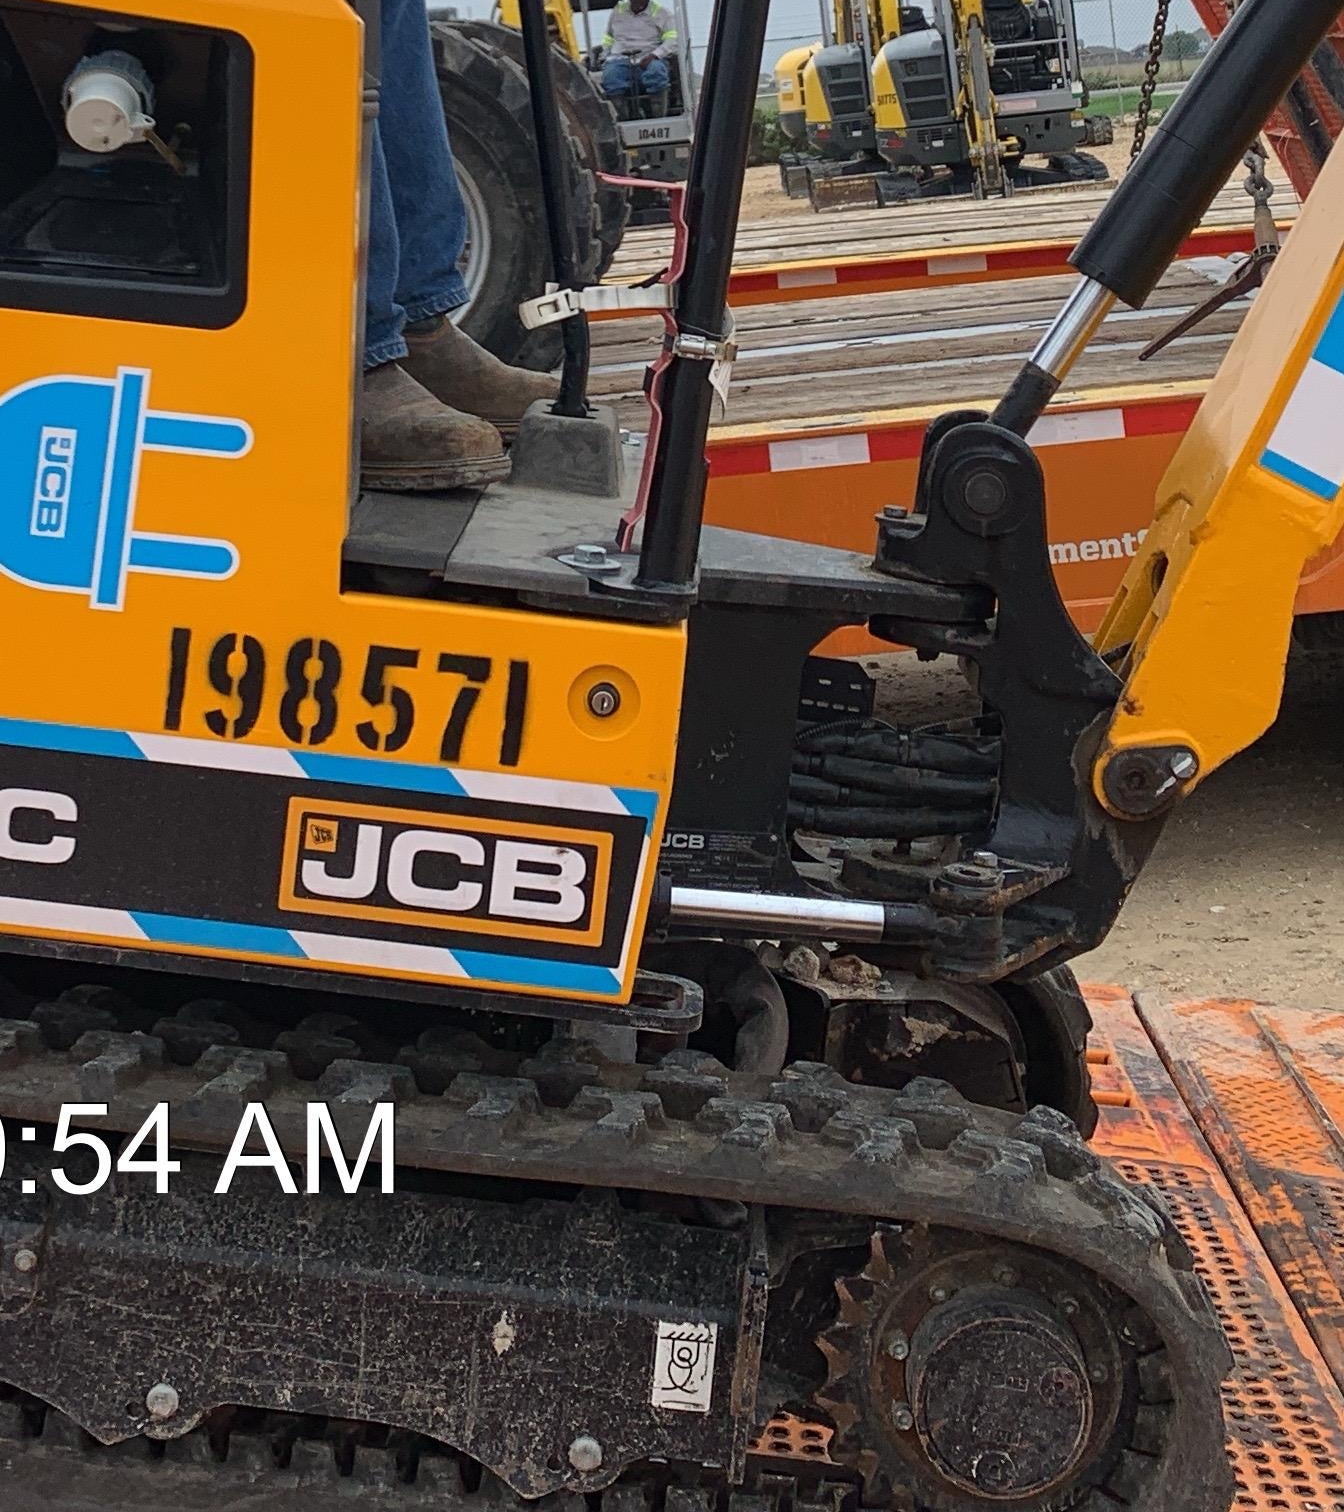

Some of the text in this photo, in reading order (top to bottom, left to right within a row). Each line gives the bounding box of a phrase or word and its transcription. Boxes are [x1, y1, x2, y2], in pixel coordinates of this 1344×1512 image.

[638, 127, 671, 141] 10487
[36, 436, 71, 532] JCB
[162, 626, 530, 768] 198571
[300, 821, 588, 925] JCB
[660, 832, 705, 849] JCB
